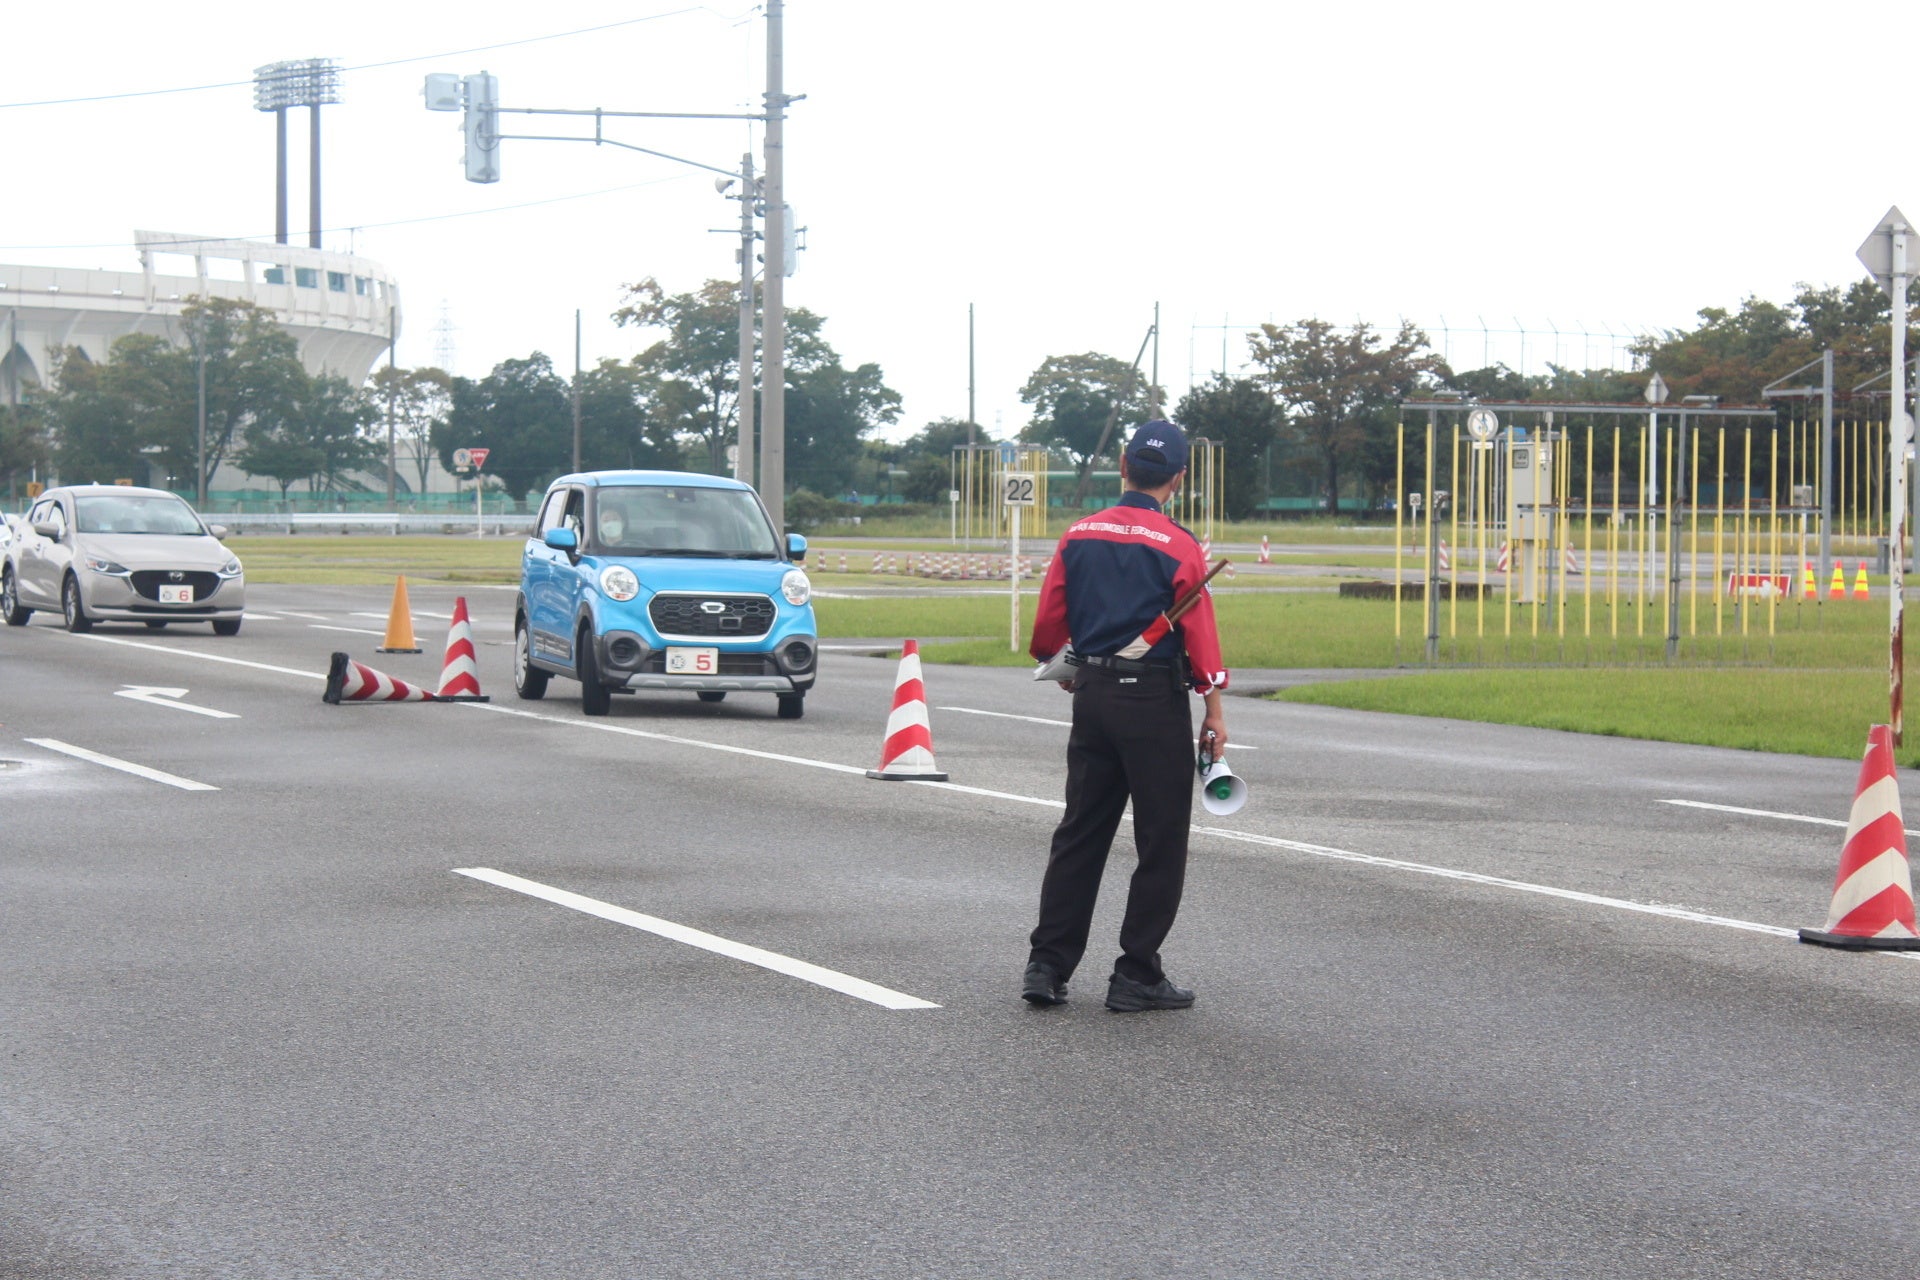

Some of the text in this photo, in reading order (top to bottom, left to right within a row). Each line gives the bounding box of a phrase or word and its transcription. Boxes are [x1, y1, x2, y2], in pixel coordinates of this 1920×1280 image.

[1146, 438, 1165, 448] JAF
[1007, 479, 1033, 501] 22
[1088, 522, 1131, 535] AUTOMOBILE
[1130, 525, 1172, 544] FEDERATION
[179, 590, 190, 602] 6
[696, 654, 712, 671] 5
